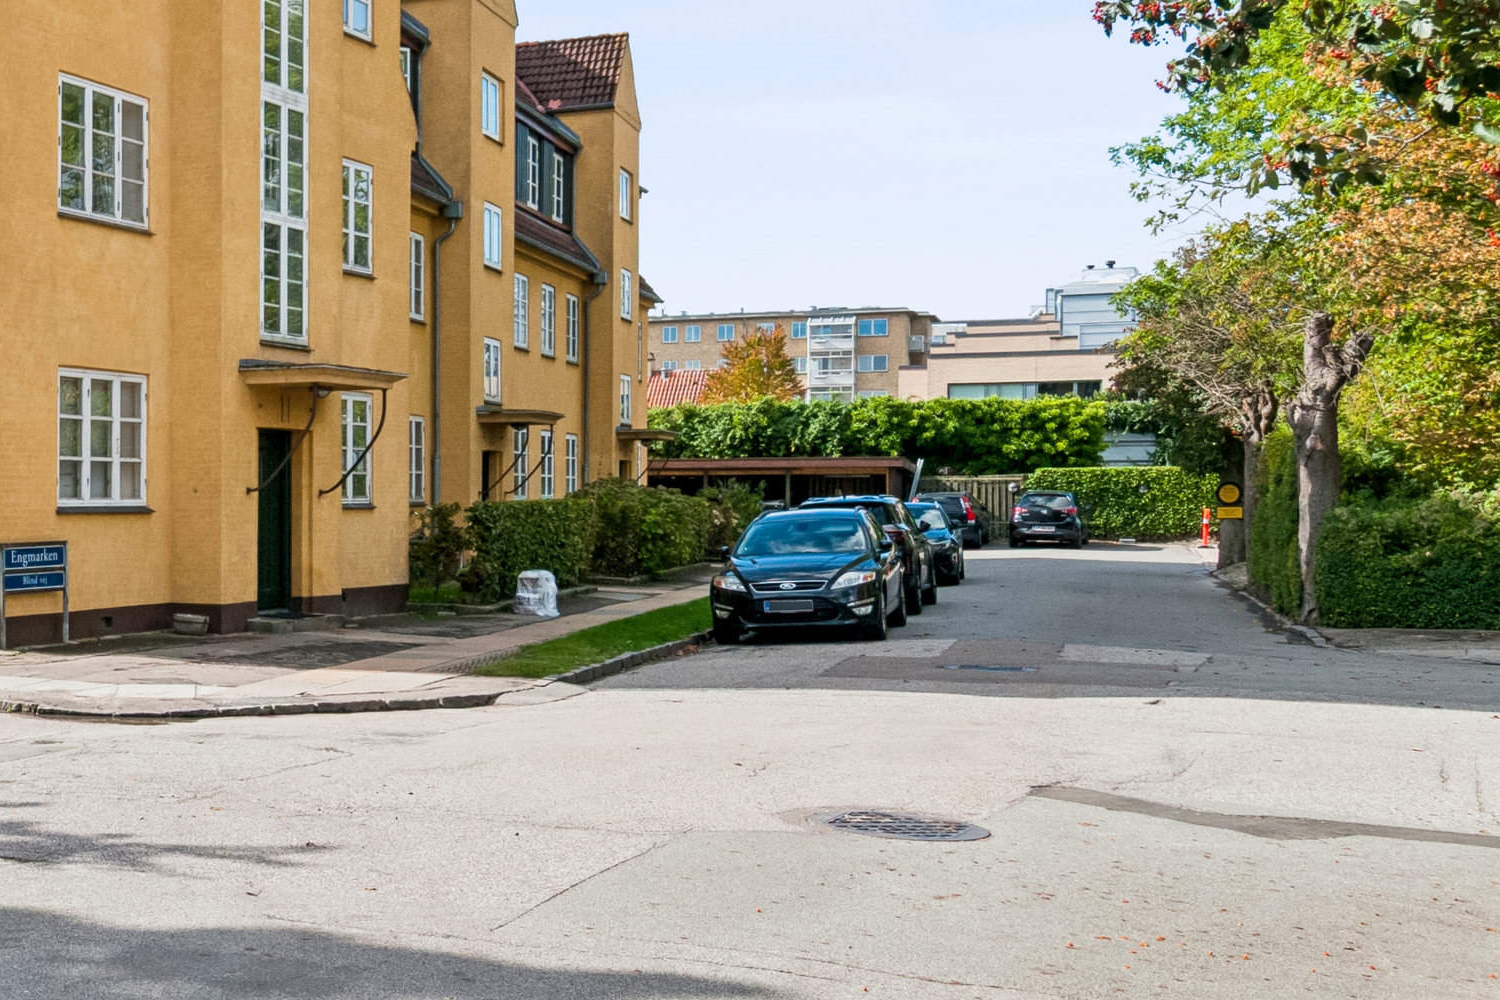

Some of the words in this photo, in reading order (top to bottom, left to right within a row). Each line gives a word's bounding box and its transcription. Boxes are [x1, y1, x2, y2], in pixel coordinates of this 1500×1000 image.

[11, 548, 58, 567] Engmarken
[22, 575, 38, 585] Blind
[40, 576, 48, 585] vej
